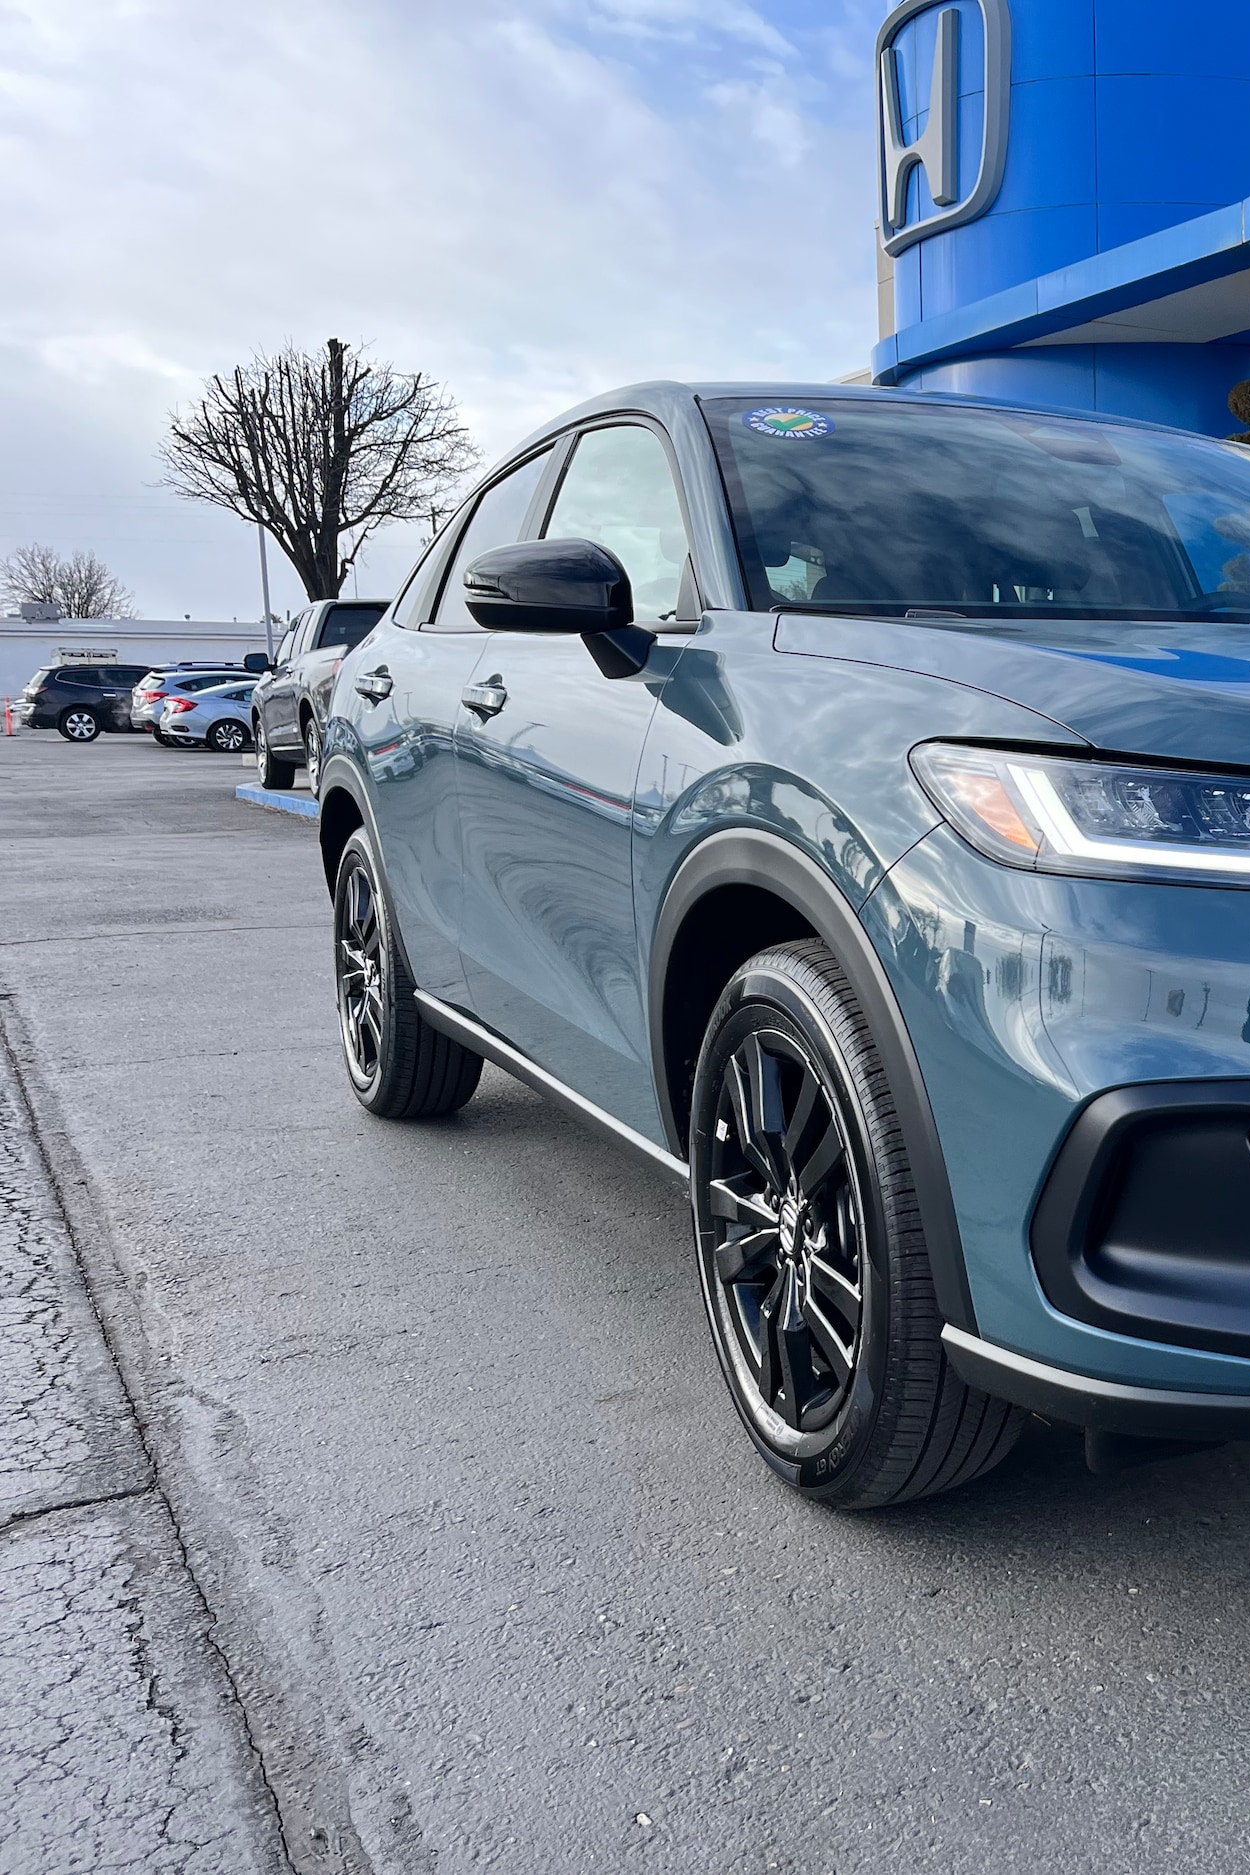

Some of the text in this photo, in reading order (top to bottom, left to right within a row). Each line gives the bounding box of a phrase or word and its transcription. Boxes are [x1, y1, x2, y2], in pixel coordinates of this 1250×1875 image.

[751, 407, 827, 422] BEST PRICE
[750, 422, 828, 438] GUARANTEE
